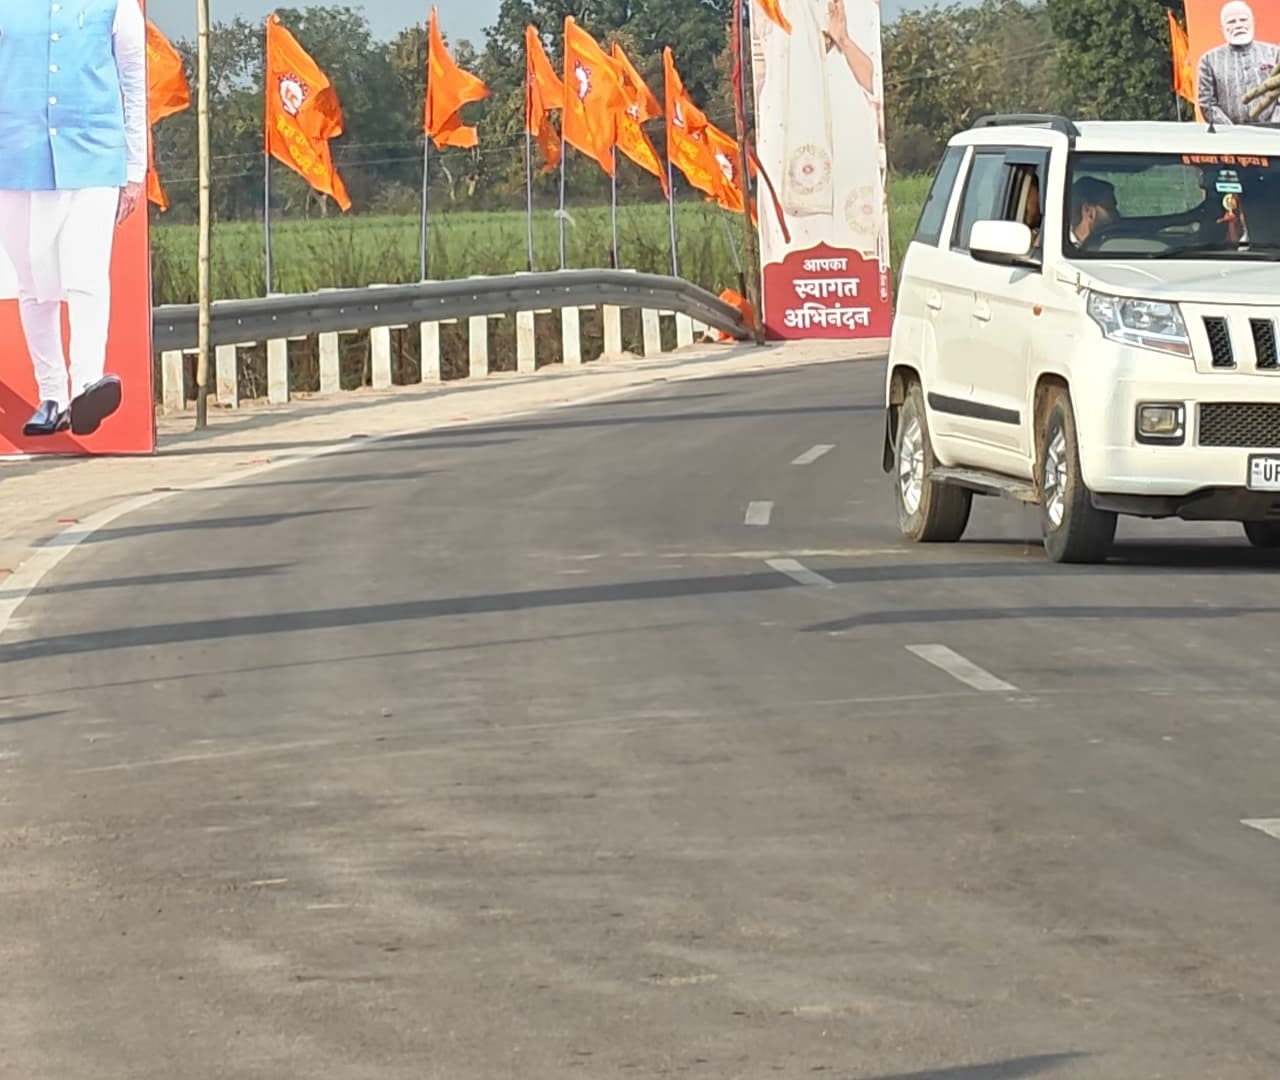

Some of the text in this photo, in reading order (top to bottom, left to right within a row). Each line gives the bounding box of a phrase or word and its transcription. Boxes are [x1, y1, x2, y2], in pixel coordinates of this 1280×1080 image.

[803, 257, 848, 272] आपका
[792, 277, 860, 299] स्वागत
[783, 302, 872, 330] अभिनंदन
